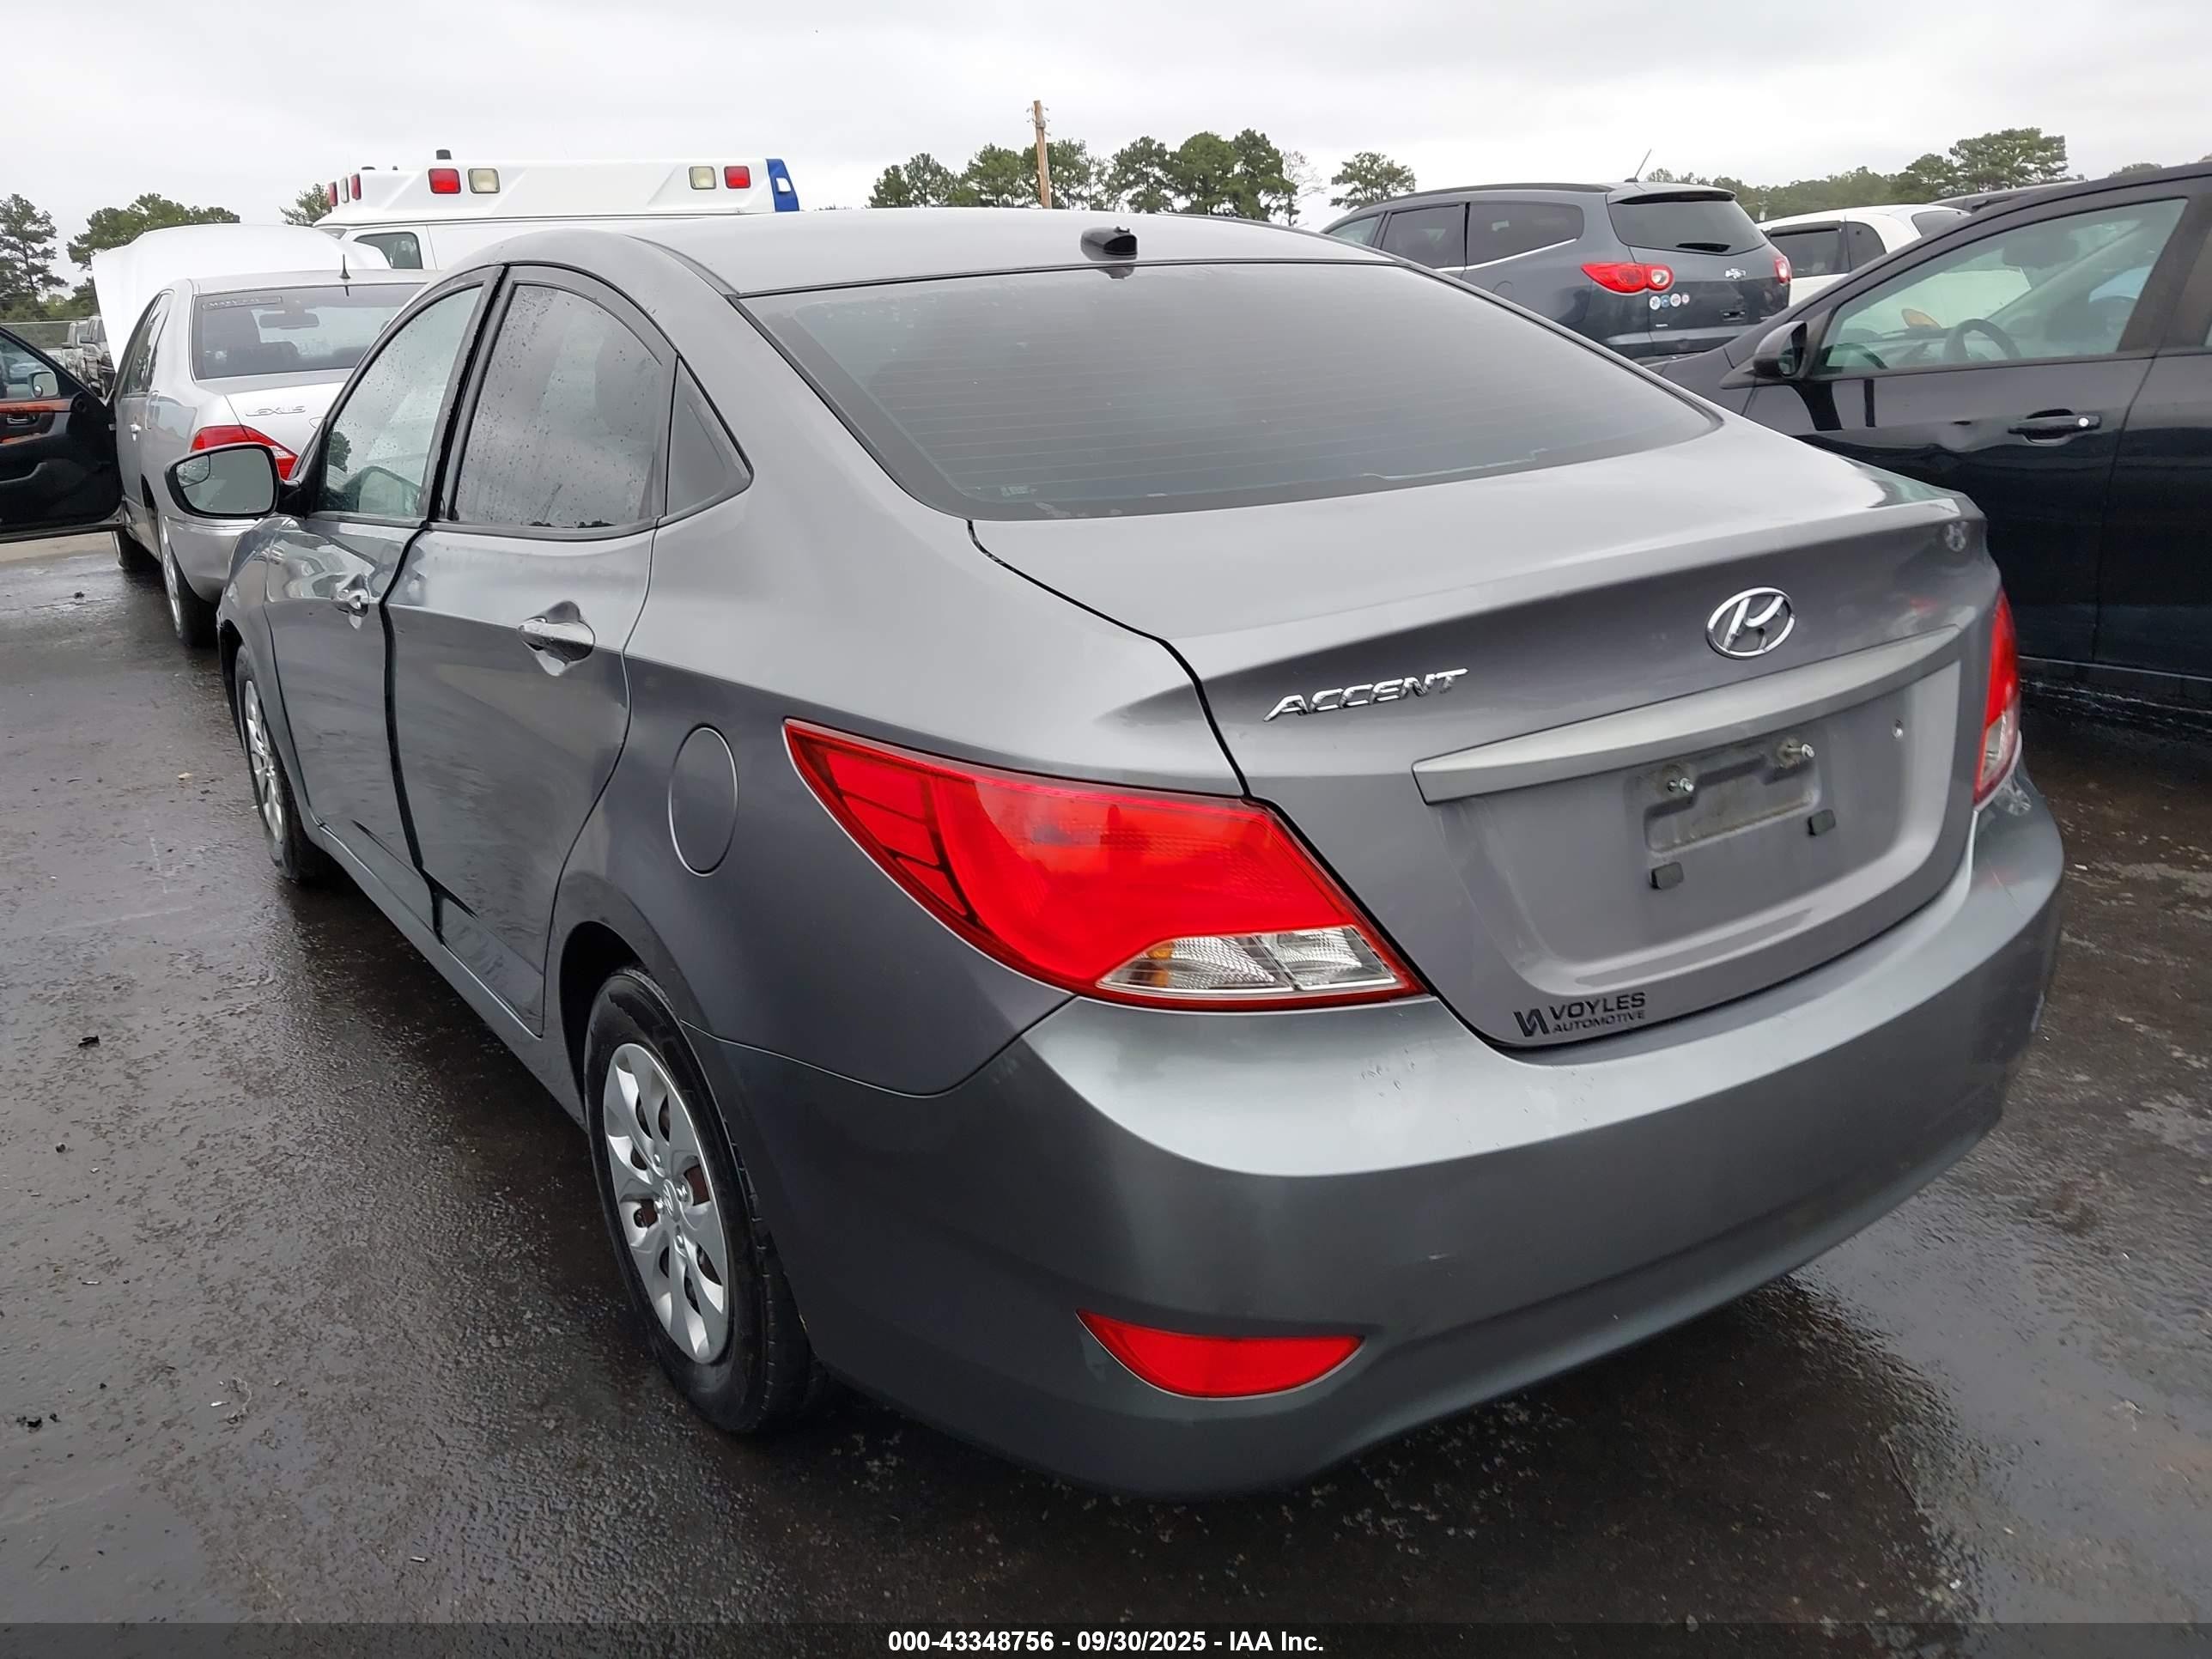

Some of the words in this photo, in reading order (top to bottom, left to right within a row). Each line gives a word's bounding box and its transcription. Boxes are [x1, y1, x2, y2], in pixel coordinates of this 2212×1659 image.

[1263, 667, 1469, 722] ACCENT
[1549, 992, 1646, 1021] VOYLES
[1553, 1009, 1645, 1034] AUTOMOTIVE
